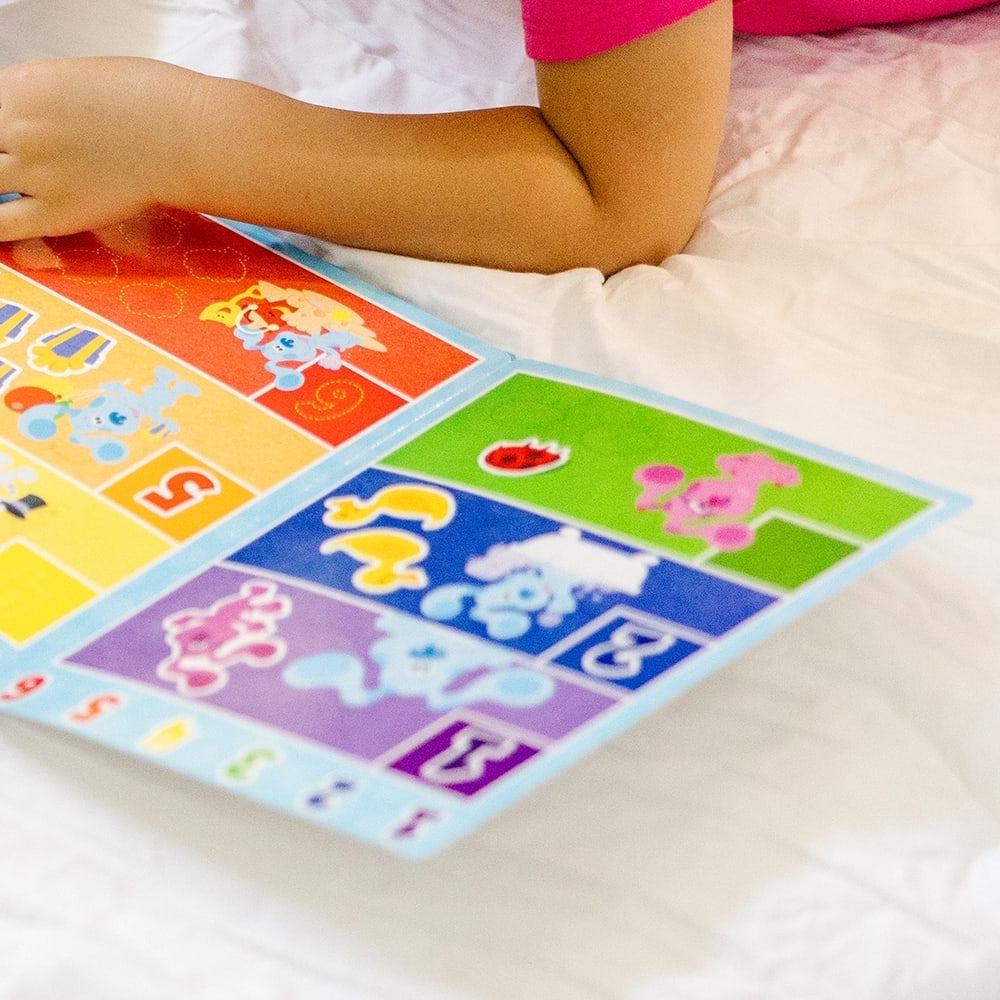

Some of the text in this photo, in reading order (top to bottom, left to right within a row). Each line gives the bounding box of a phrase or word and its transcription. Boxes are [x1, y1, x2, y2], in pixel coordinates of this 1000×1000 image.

[293, 379, 365, 422] 6
[145, 469, 216, 513] 5
[586, 625, 673, 677] 2
[69, 694, 122, 723] 5
[422, 730, 513, 782] 1
